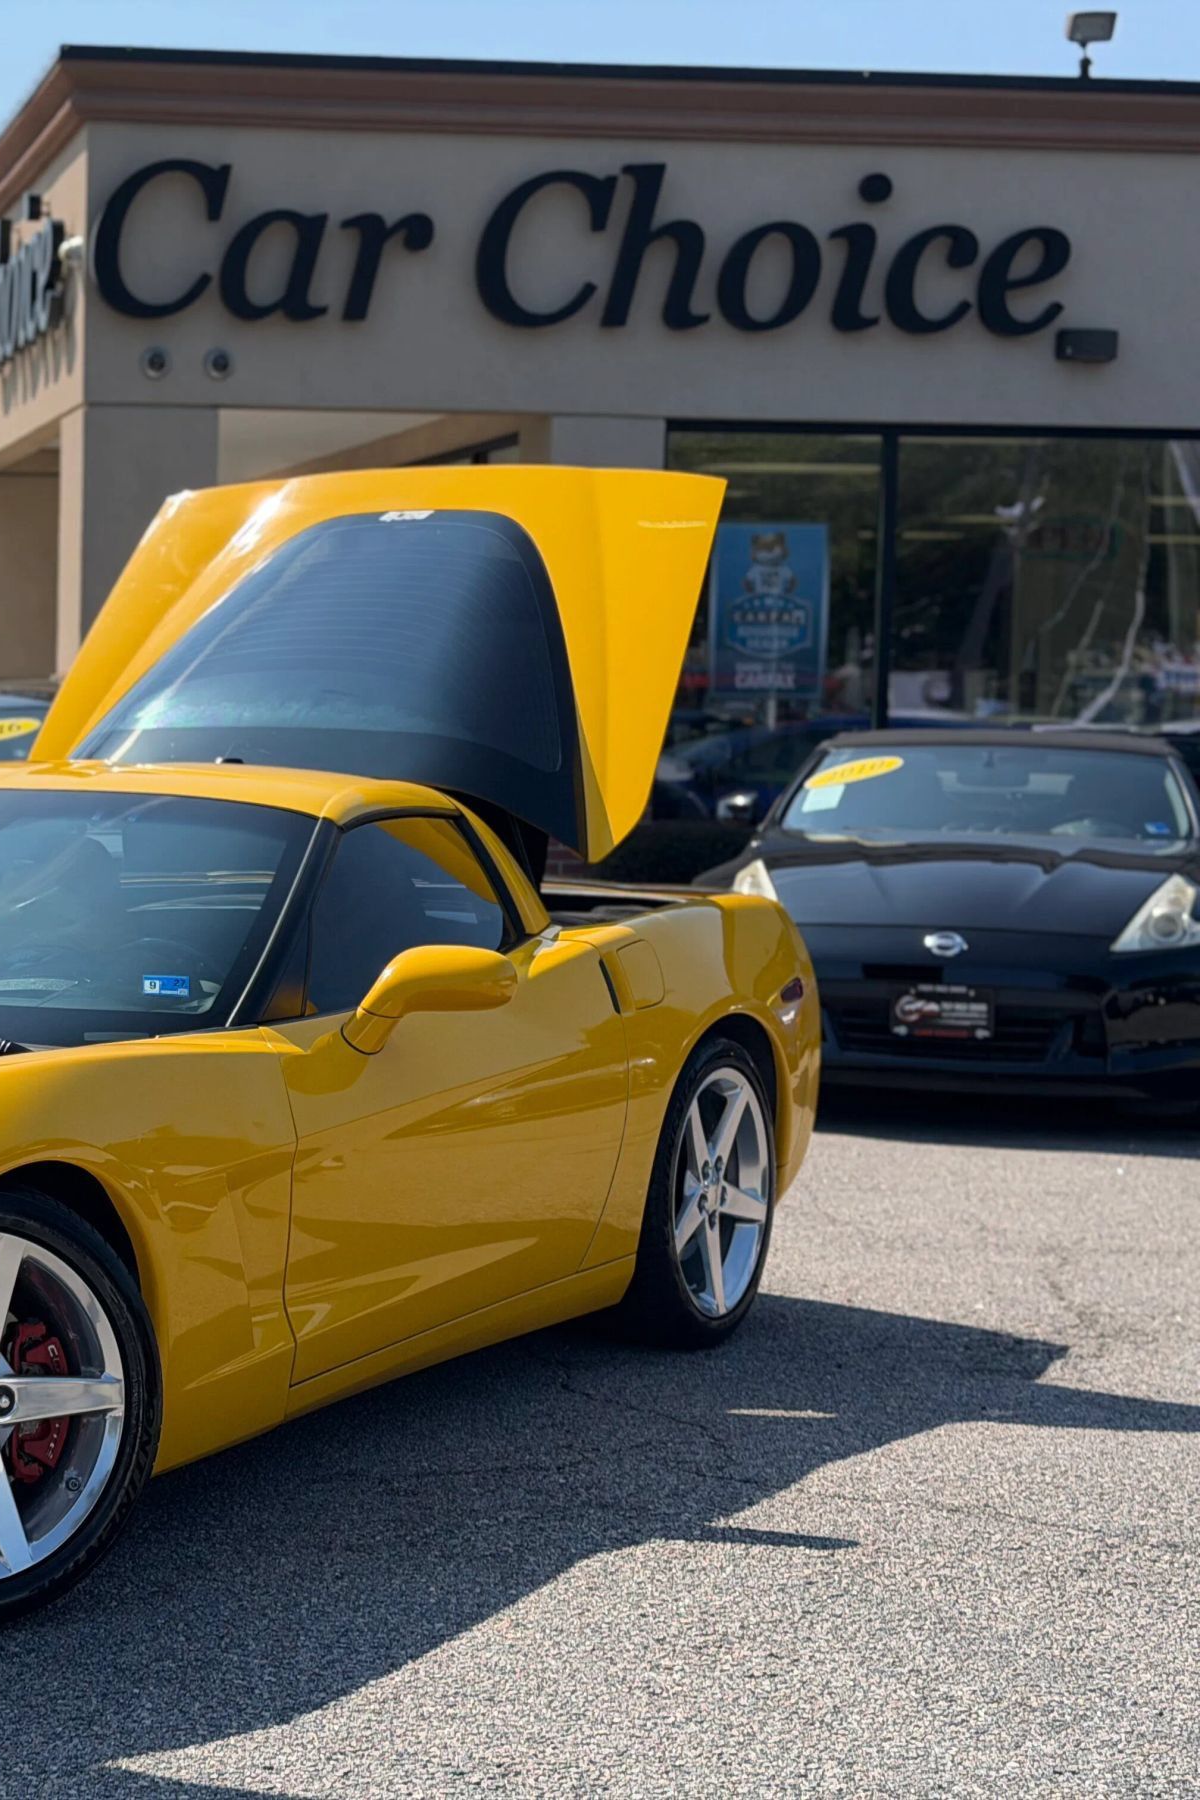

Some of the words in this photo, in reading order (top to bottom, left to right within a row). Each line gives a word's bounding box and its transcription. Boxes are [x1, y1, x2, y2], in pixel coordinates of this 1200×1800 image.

[92, 158, 435, 321] Car
[475, 163, 1072, 336] Choice
[150, 981, 156, 990] 9
